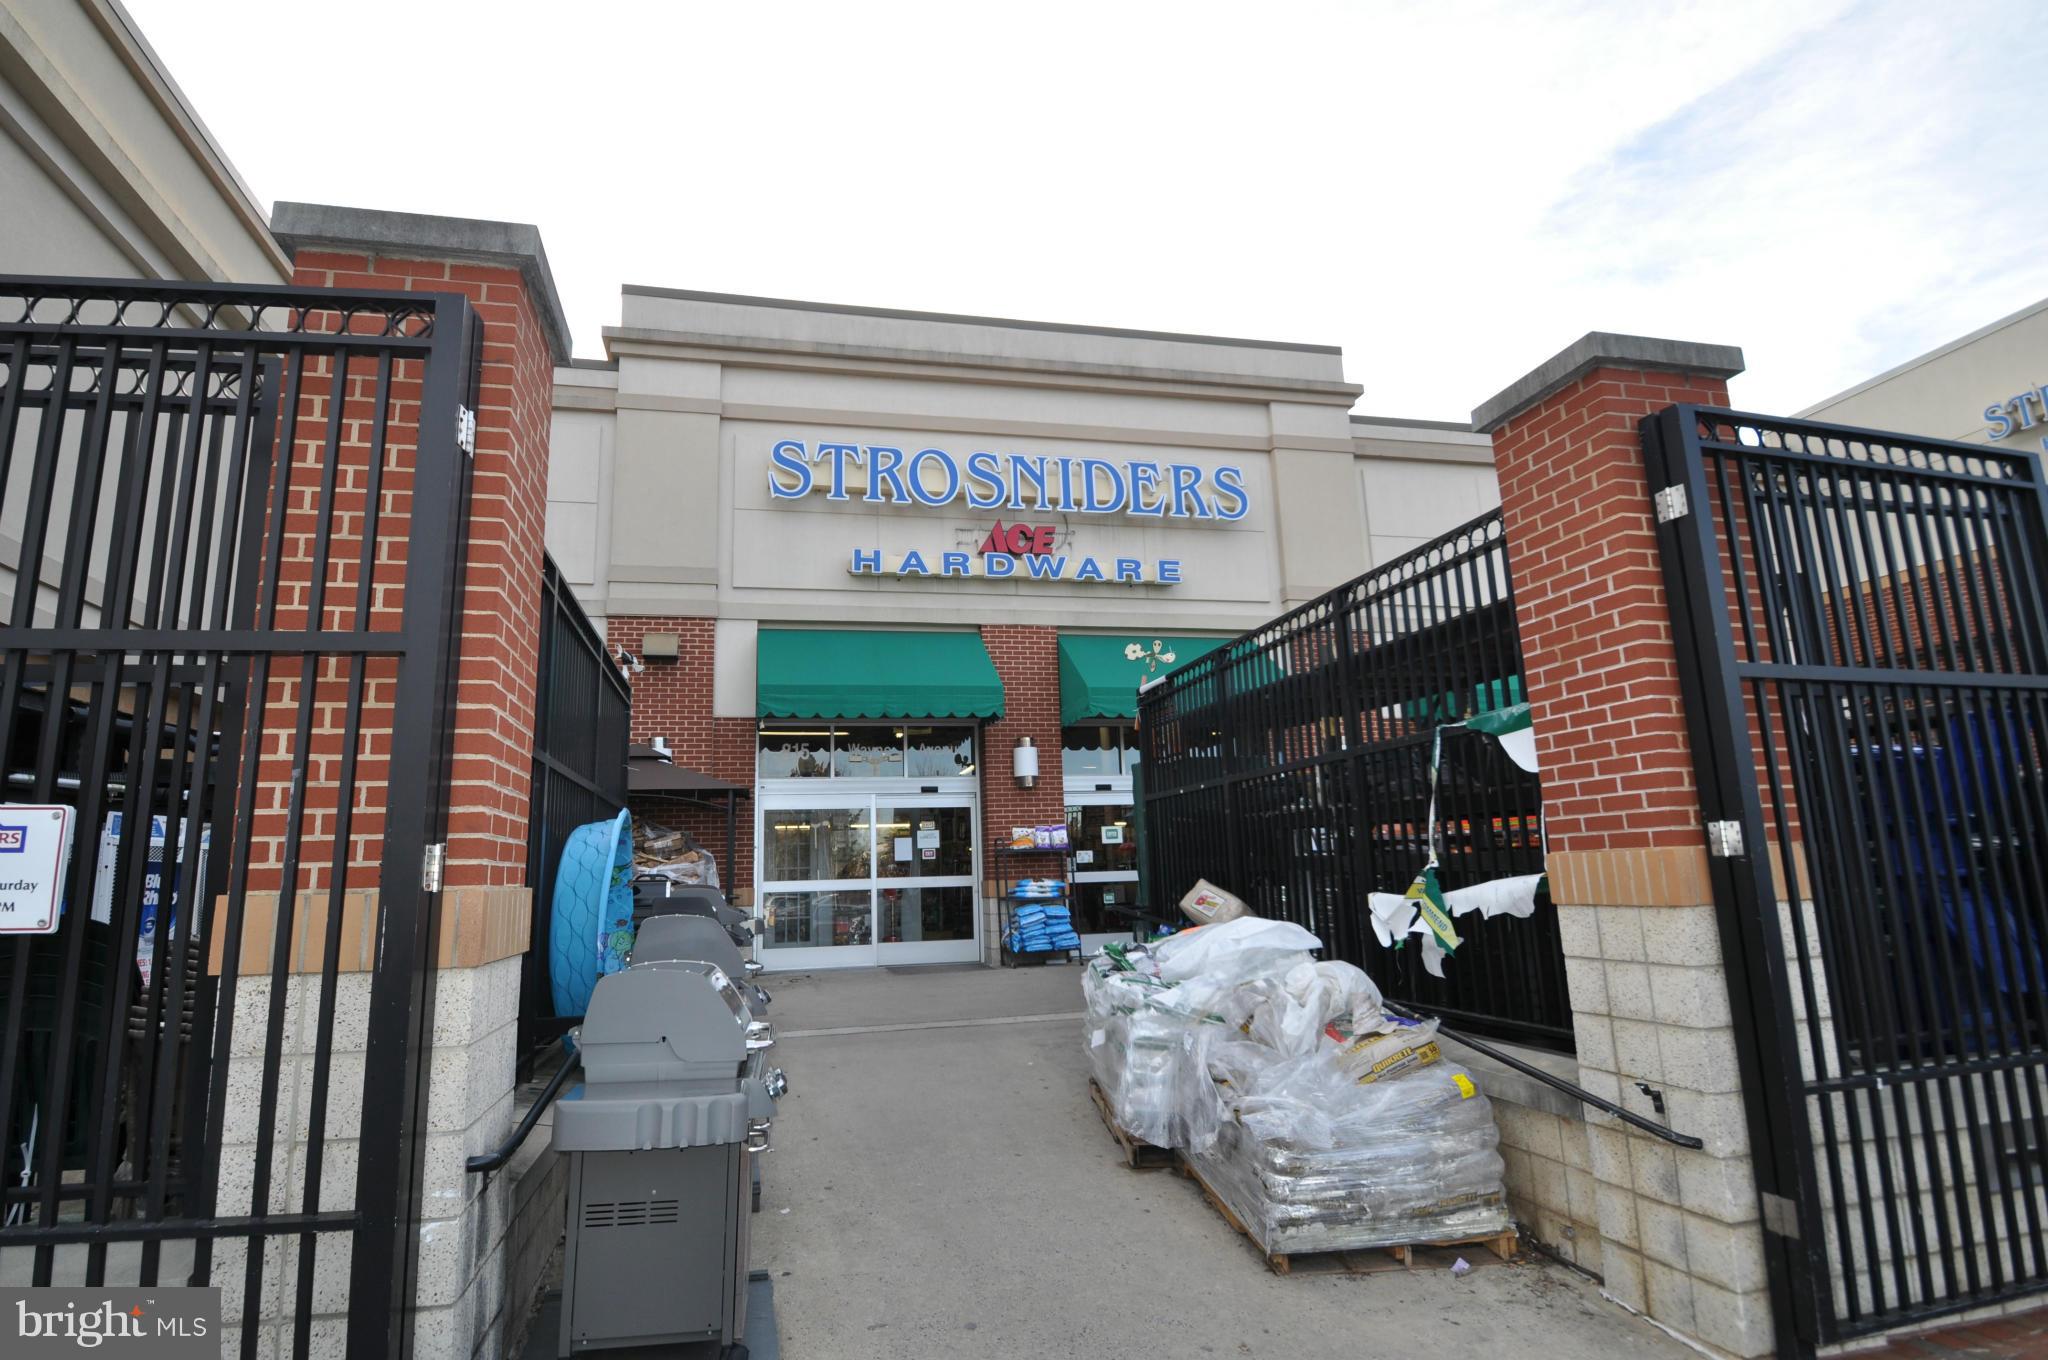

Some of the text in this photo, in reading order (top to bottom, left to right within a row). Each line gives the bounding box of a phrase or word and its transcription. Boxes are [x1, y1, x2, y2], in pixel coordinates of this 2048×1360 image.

[767, 438, 1250, 521] STROSNIDERS
[978, 519, 1057, 555] ACE
[851, 548, 1184, 584] HARDWARE
